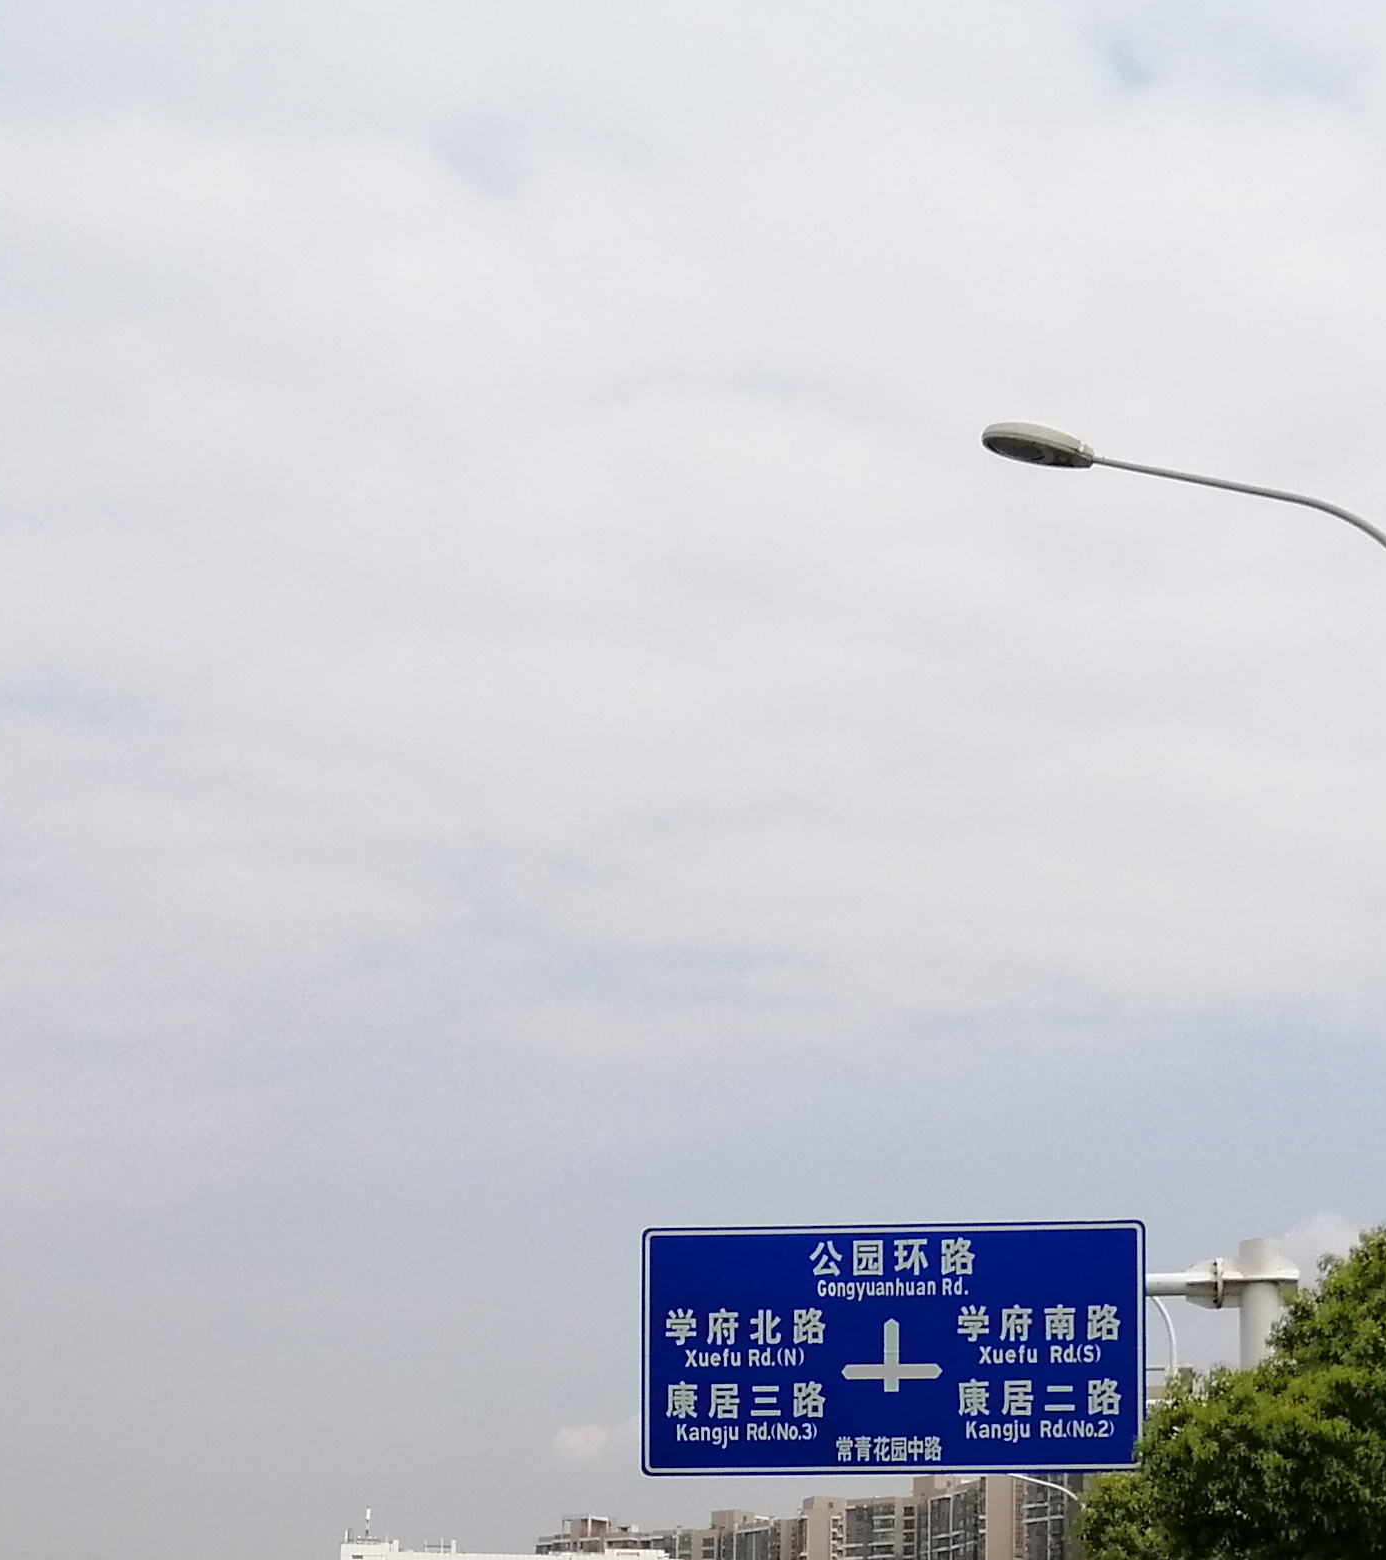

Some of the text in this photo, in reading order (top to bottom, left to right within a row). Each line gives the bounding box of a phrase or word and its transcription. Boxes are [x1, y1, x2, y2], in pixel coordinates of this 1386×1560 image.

[809, 1236, 976, 1277] 公园环路
[817, 1276, 969, 1302] Gongyuanhuan Rd.
[665, 1307, 826, 1346] 学府北路
[957, 1303, 1121, 1342] 学府南路
[684, 1347, 805, 1368] Xuefu Rd.(N)
[978, 1343, 1101, 1365] Xuefu Rd.(S)
[665, 1380, 826, 1420] 康居三路
[957, 1377, 1122, 1417] 康居二路
[676, 1421, 818, 1450] Kangju Rd.(No.3)
[965, 1418, 1115, 1443] Kangju Rd.(No.2)
[835, 1435, 942, 1462] 常青花园中路
